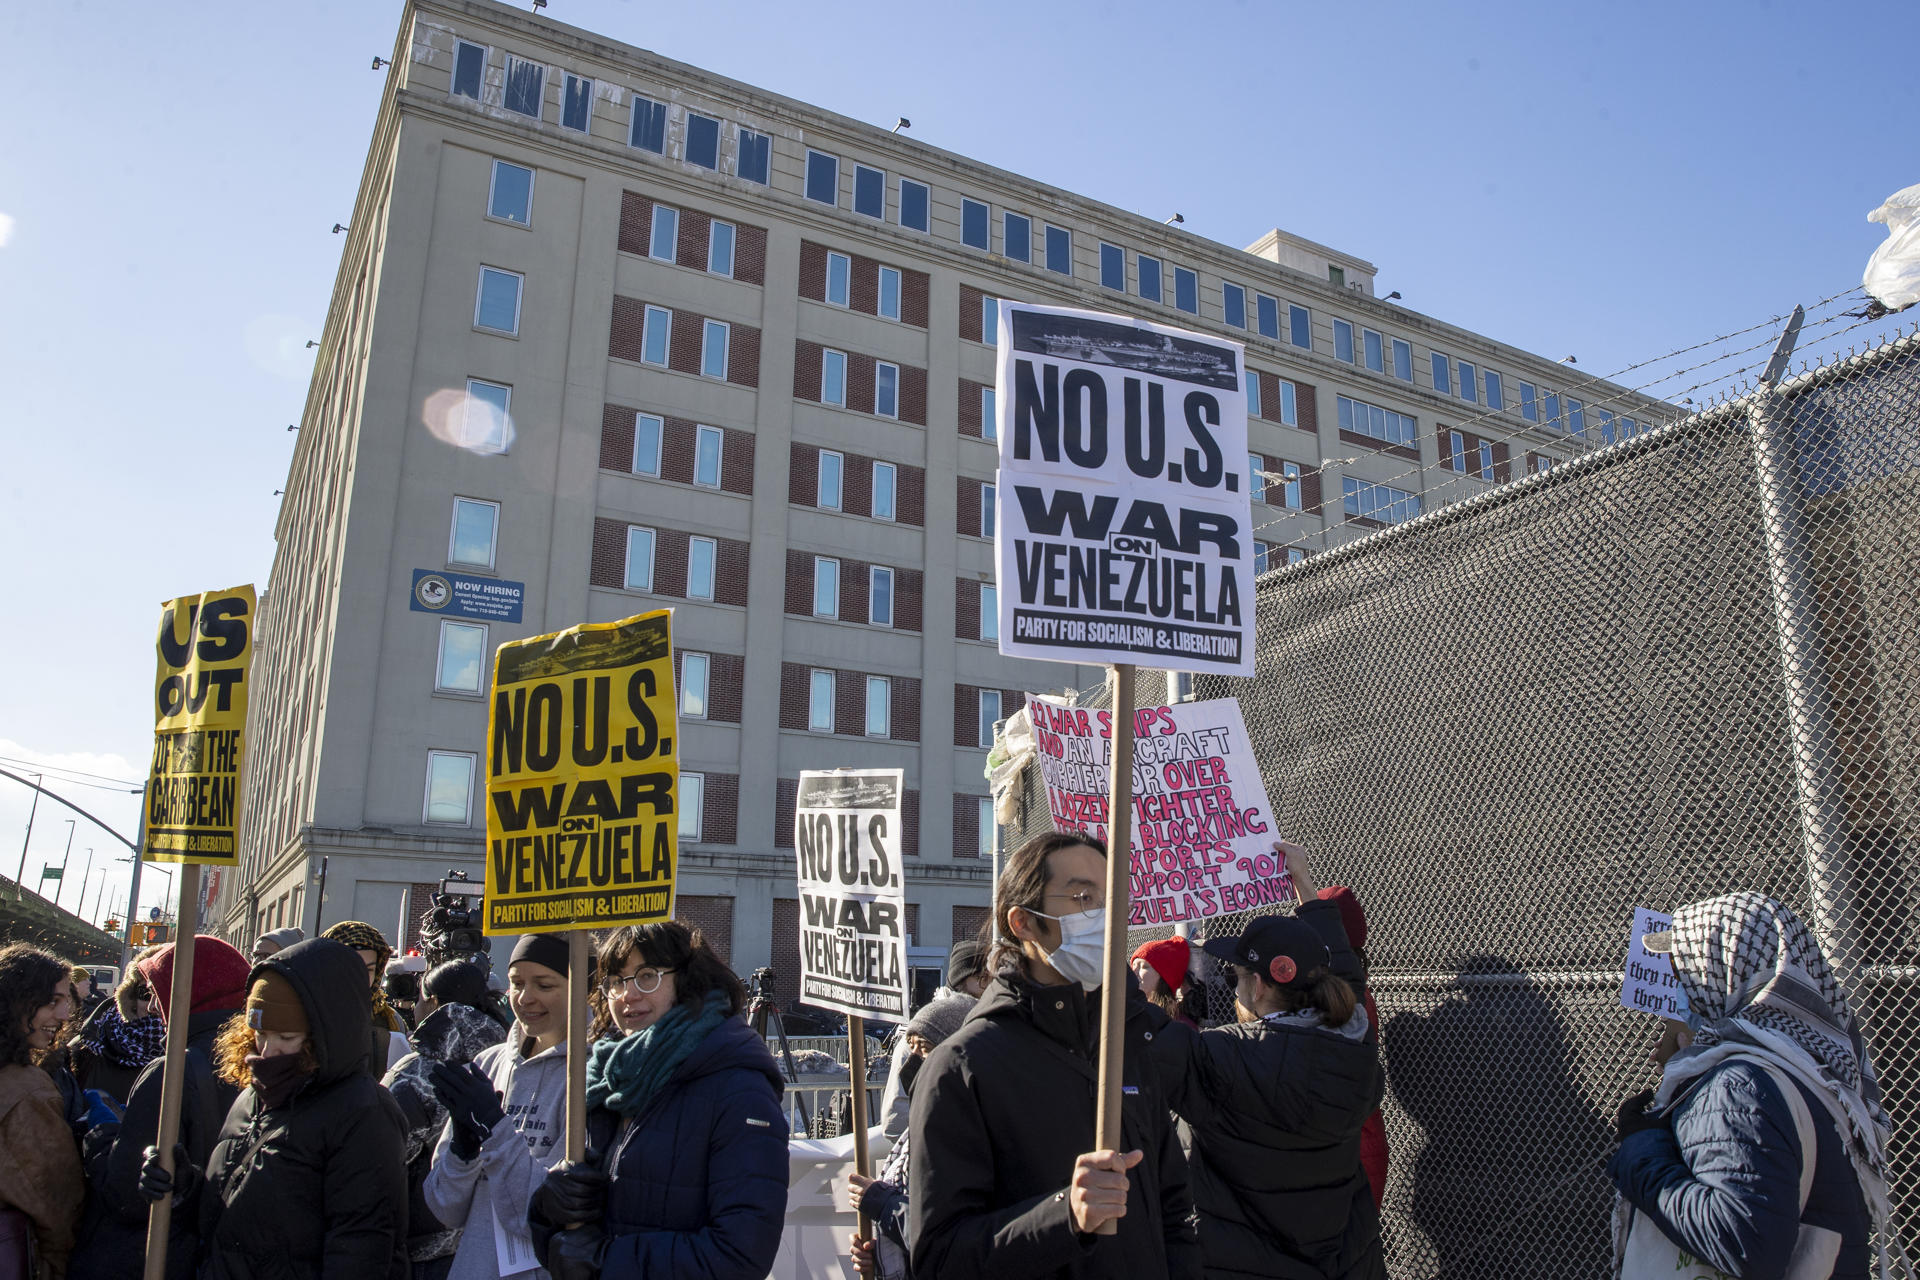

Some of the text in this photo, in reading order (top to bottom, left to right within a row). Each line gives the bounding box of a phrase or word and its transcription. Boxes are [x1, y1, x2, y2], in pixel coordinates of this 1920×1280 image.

[1013, 358, 1239, 494] NO U.S.
[1013, 485, 1241, 560] WAR
[1113, 537, 1152, 555] ON
[455, 581, 520, 597] NOW HIRING
[1013, 539, 1242, 627] VENEZUELA
[160, 597, 248, 667] US
[1016, 616, 1238, 657] PARTY FOR SOCIALISM & LIBERATION
[159, 668, 243, 717] OUT
[492, 669, 672, 777] NO U.S.
[1030, 700, 1177, 738] 12 WAR SIPS
[155, 730, 240, 774] OF THE
[1039, 727, 1230, 766] AND AN ACRAFT
[1041, 754, 1110, 794] CARRIER
[1163, 756, 1232, 790] OVER
[150, 776, 235, 826] CARIBBEAN
[492, 773, 674, 832] WAR
[1049, 785, 1240, 823] A DOZEN IGHTER
[189, 836, 196, 851] &
[197, 835, 233, 853] LIBERATION
[563, 817, 594, 832] ON
[1138, 807, 1268, 850] BLOCKING
[492, 822, 672, 895] VENEZUELA
[799, 813, 898, 888] NO U.S.
[1130, 841, 1236, 875] XPORTS
[1129, 865, 1222, 898] UPPORT
[494, 892, 668, 924] PARTY FOR SOCIALISM & LIBERATION
[803, 894, 900, 938] WAR
[837, 927, 853, 939] ON
[804, 930, 903, 989] VENEZUELA
[1630, 960, 1679, 988] they re
[806, 979, 901, 1012] PARTY FOR SOCIALISM & LIBERATION
